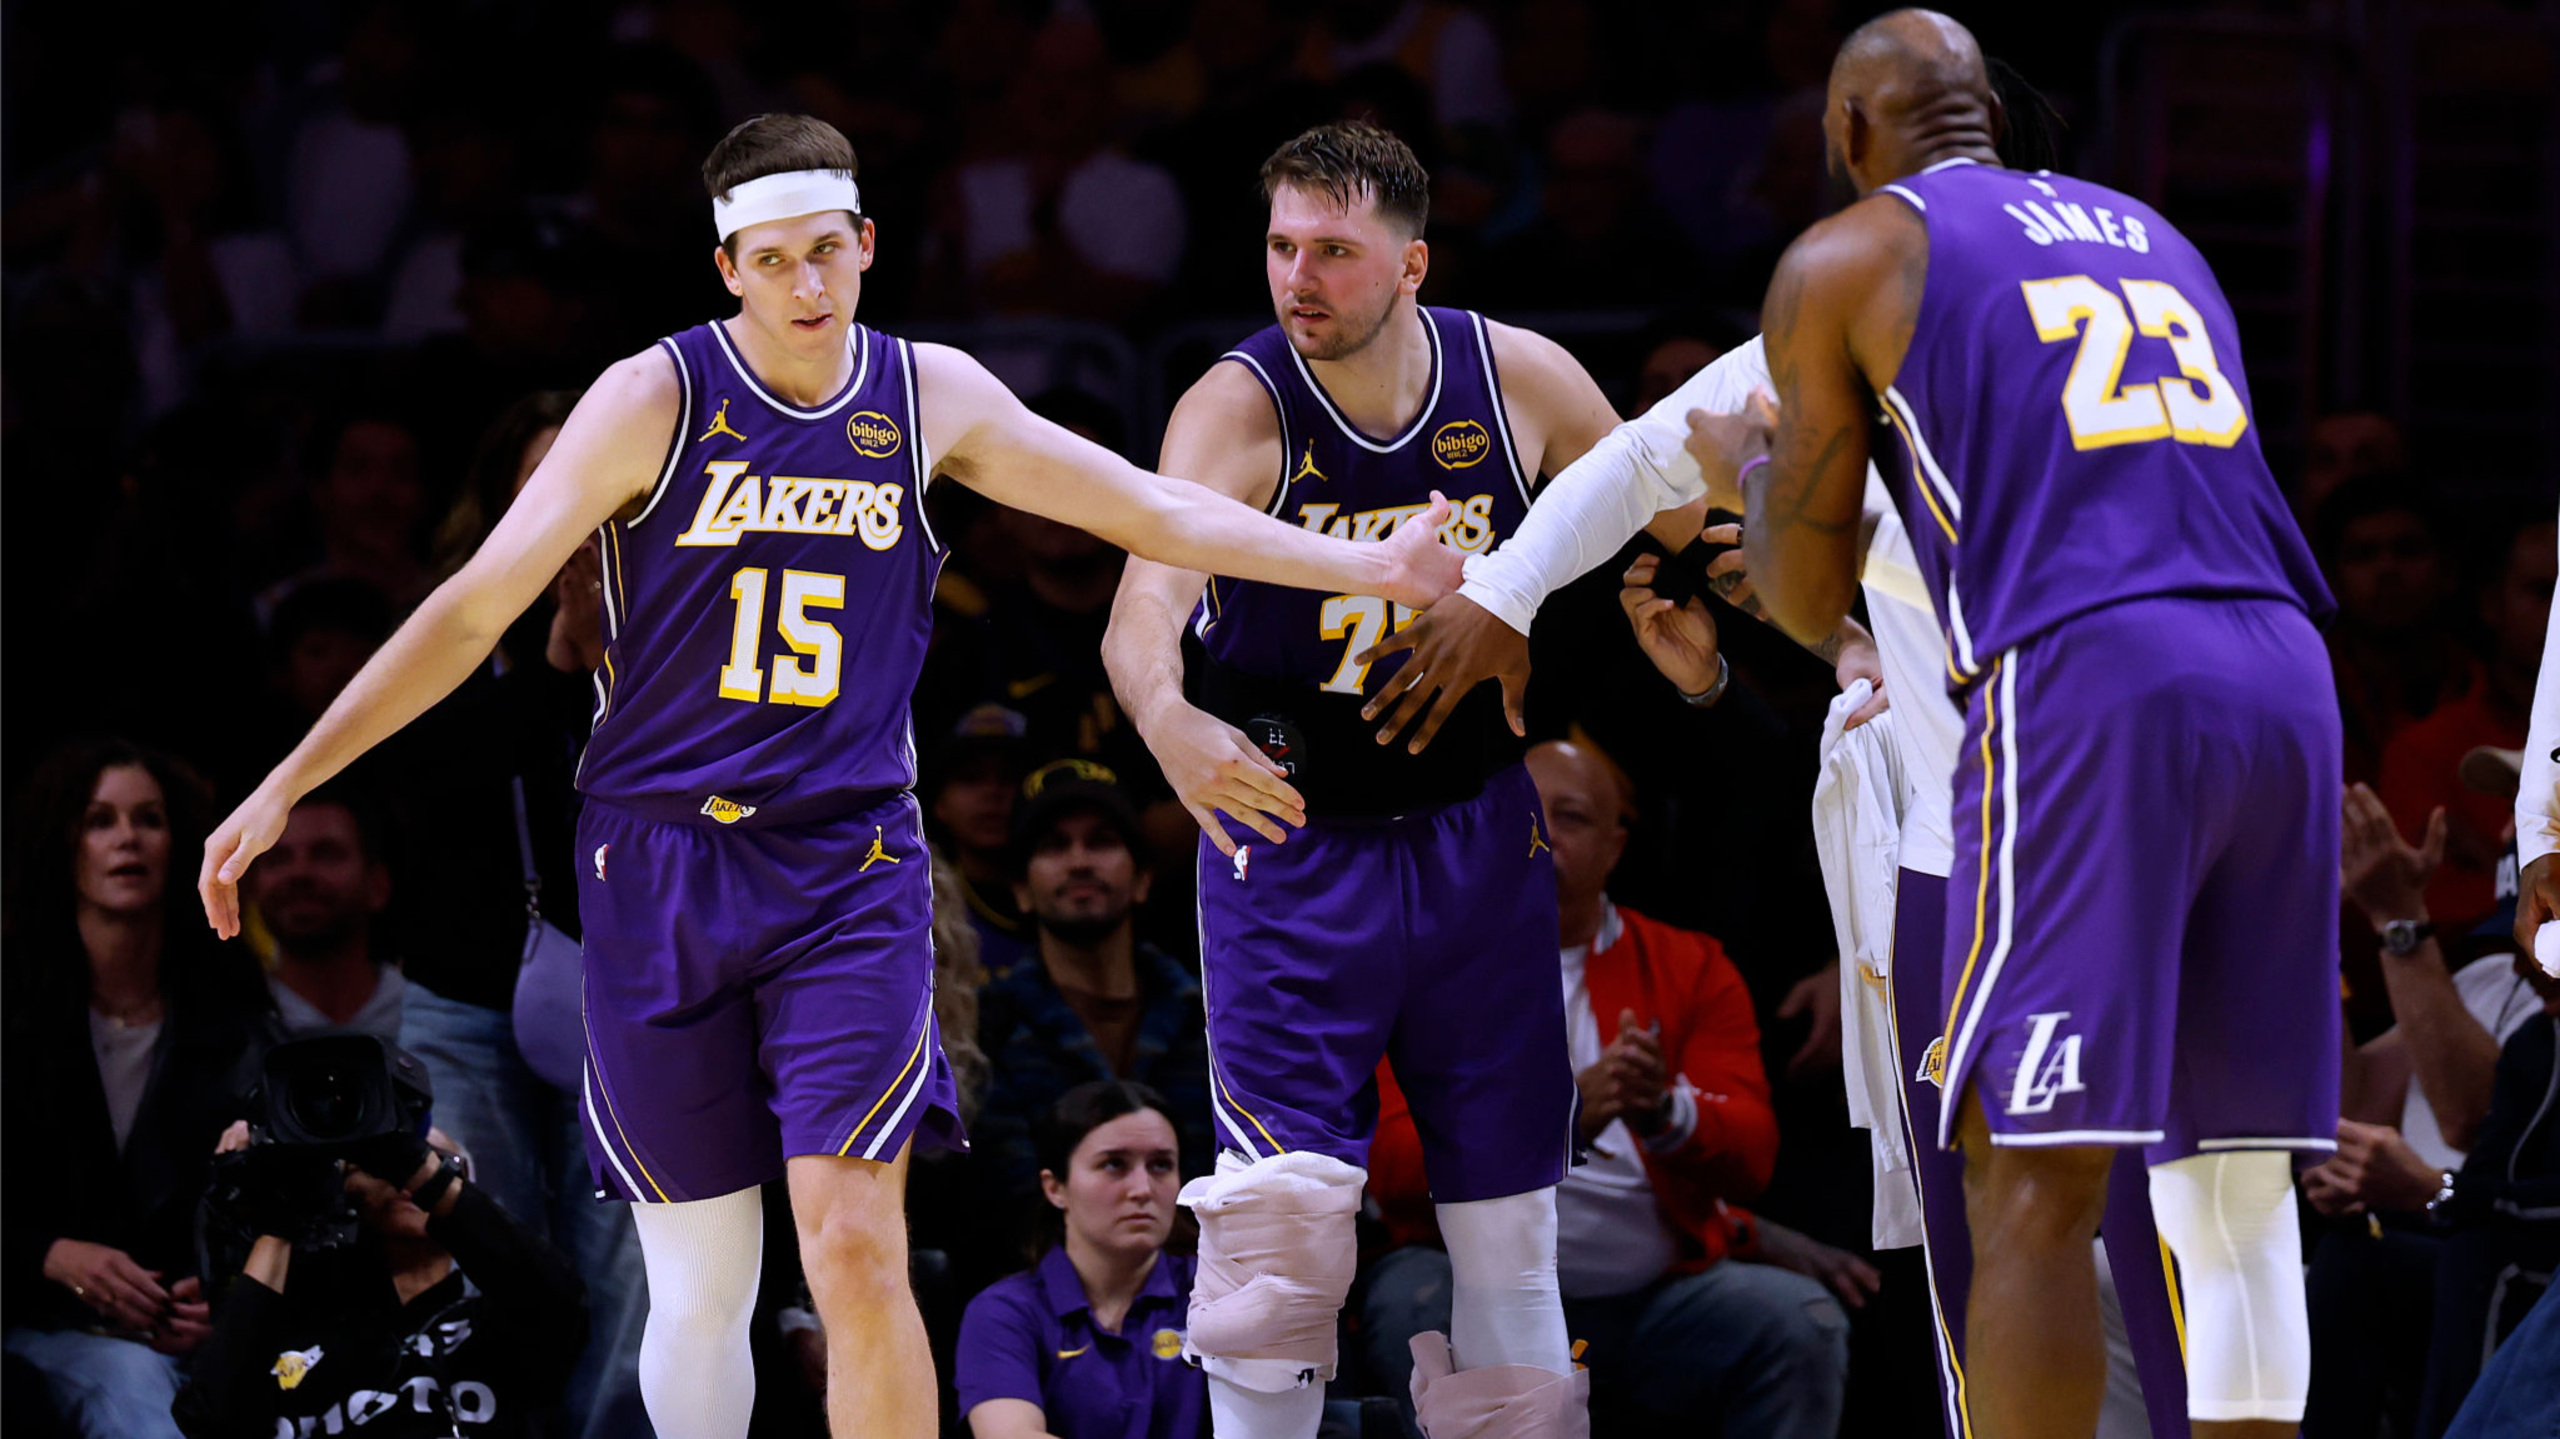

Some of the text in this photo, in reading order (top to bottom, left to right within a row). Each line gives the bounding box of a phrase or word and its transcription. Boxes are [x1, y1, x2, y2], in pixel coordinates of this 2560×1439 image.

[2003, 200, 2150, 253] JAMES
[2020, 274, 2249, 451] 23
[851, 421, 898, 446] bibigo
[1437, 432, 1487, 453] bibigo
[674, 460, 905, 551] LAKERS
[718, 566, 846, 708] 15
[2004, 1011, 2087, 1116] LA
